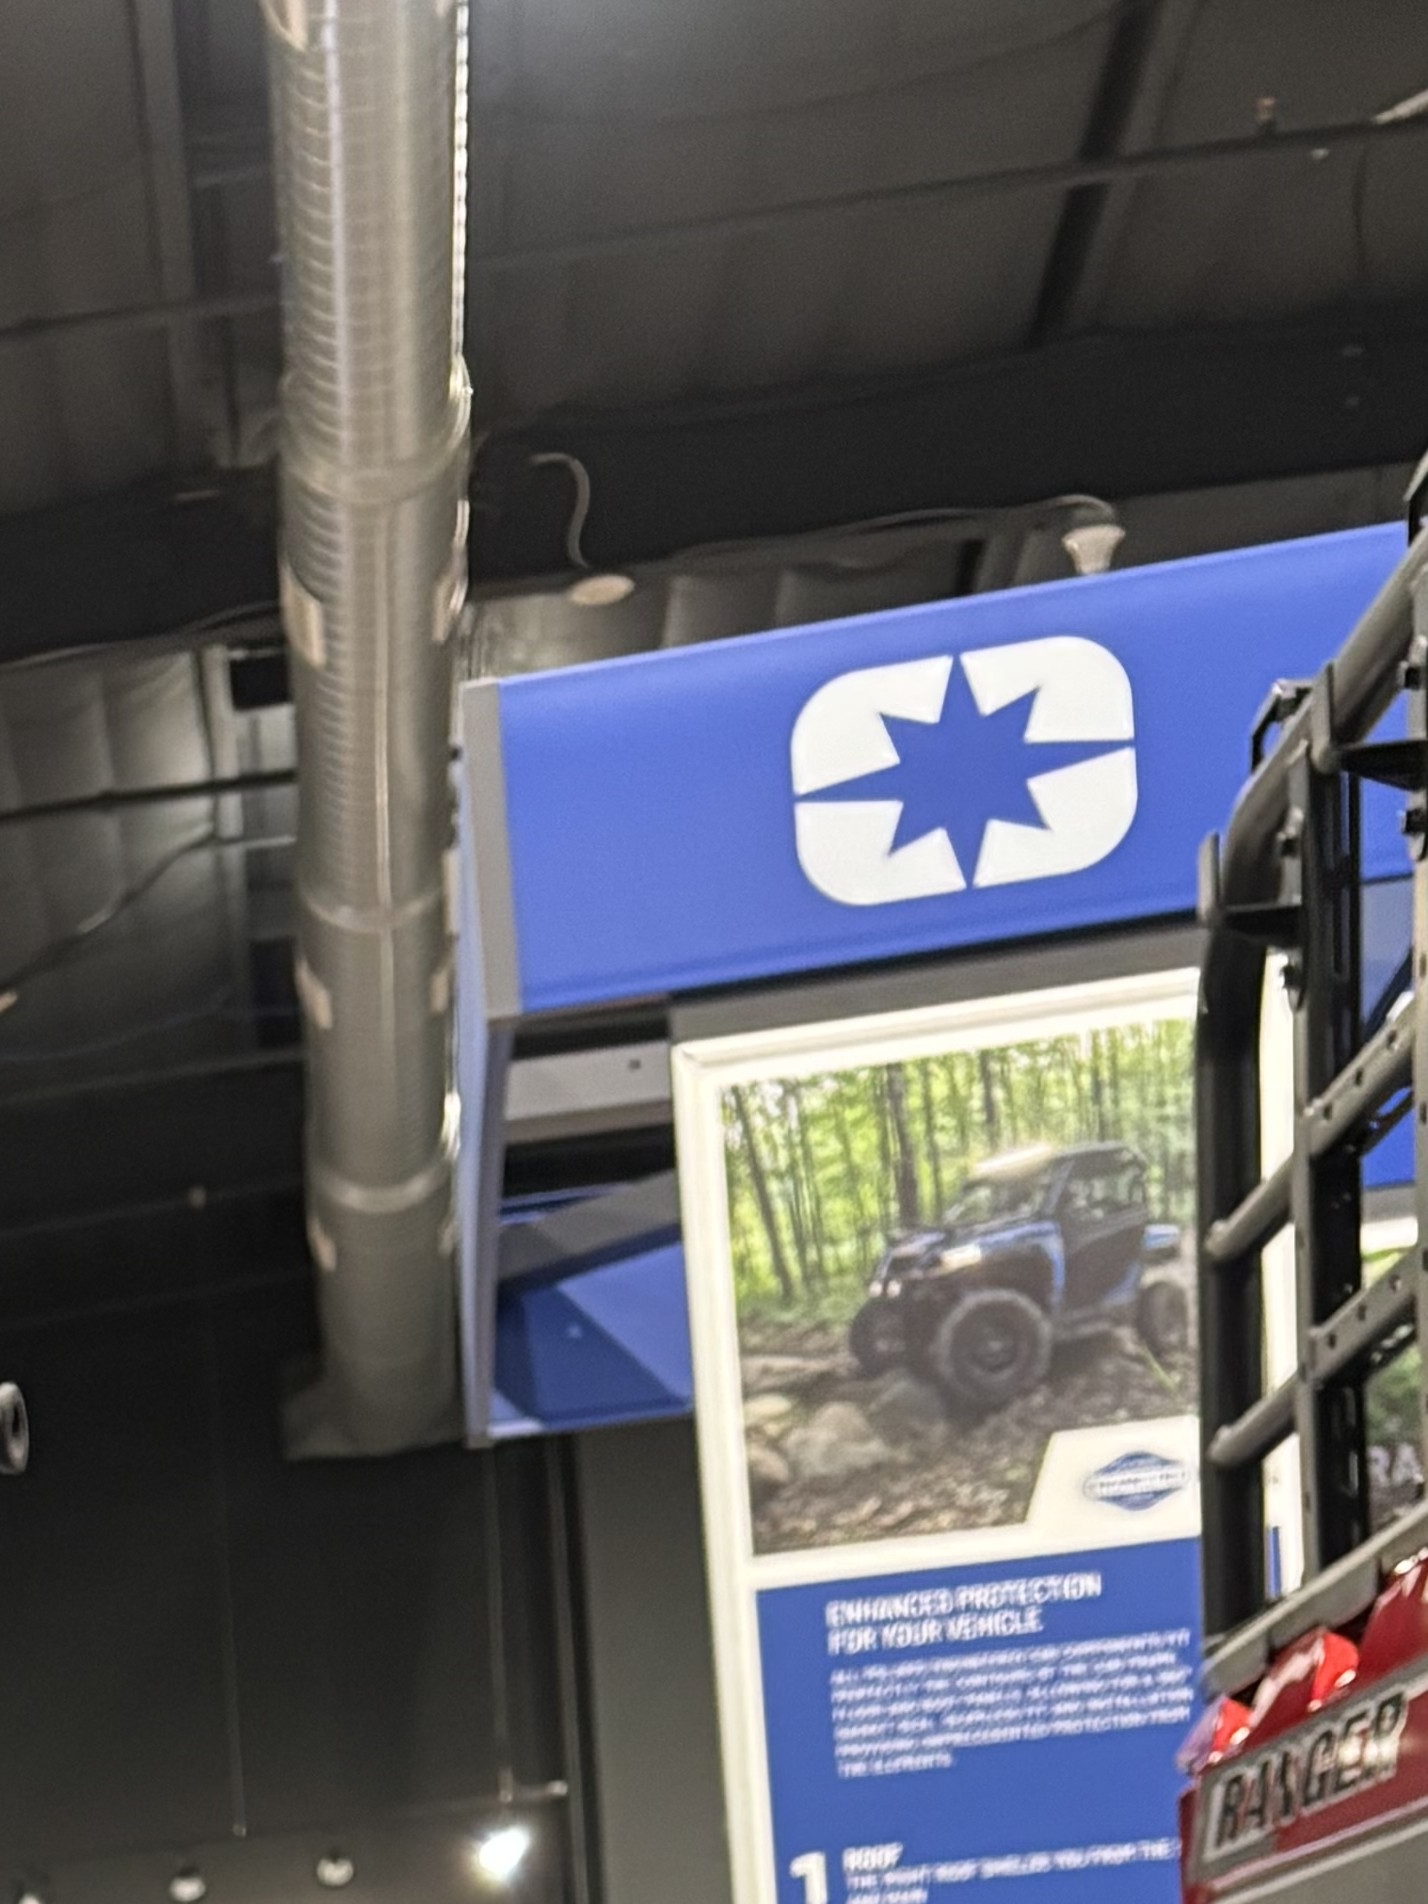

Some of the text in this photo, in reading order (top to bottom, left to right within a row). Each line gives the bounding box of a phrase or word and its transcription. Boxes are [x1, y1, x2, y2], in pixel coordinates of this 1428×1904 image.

[826, 1571, 1103, 1627] ENHANCED PROTECTION
[828, 1607, 1044, 1655] FOR YOUR VEHICLE
[1212, 1690, 1405, 1850] RANGER
